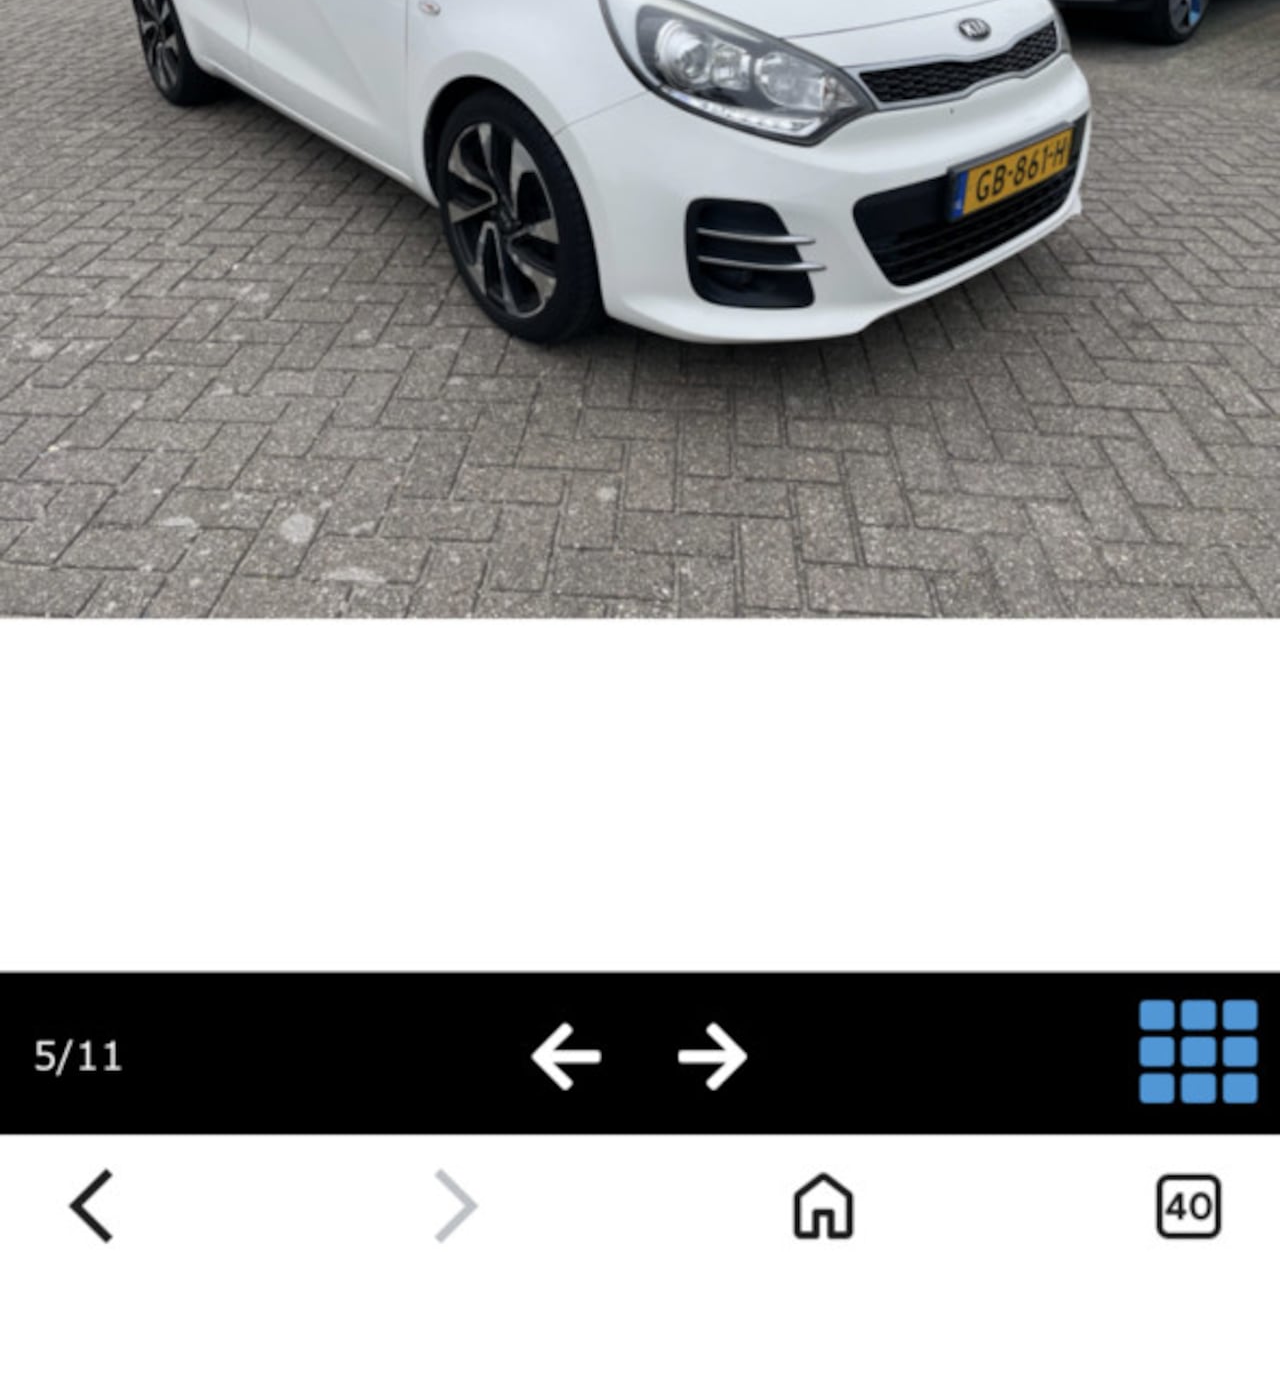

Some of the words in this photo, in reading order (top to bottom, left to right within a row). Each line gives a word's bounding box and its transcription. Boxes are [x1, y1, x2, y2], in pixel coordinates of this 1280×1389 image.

[976, 136, 1067, 202] GB-861-H
[34, 1038, 122, 1077] 5/11
[1165, 1192, 1213, 1221] 40
